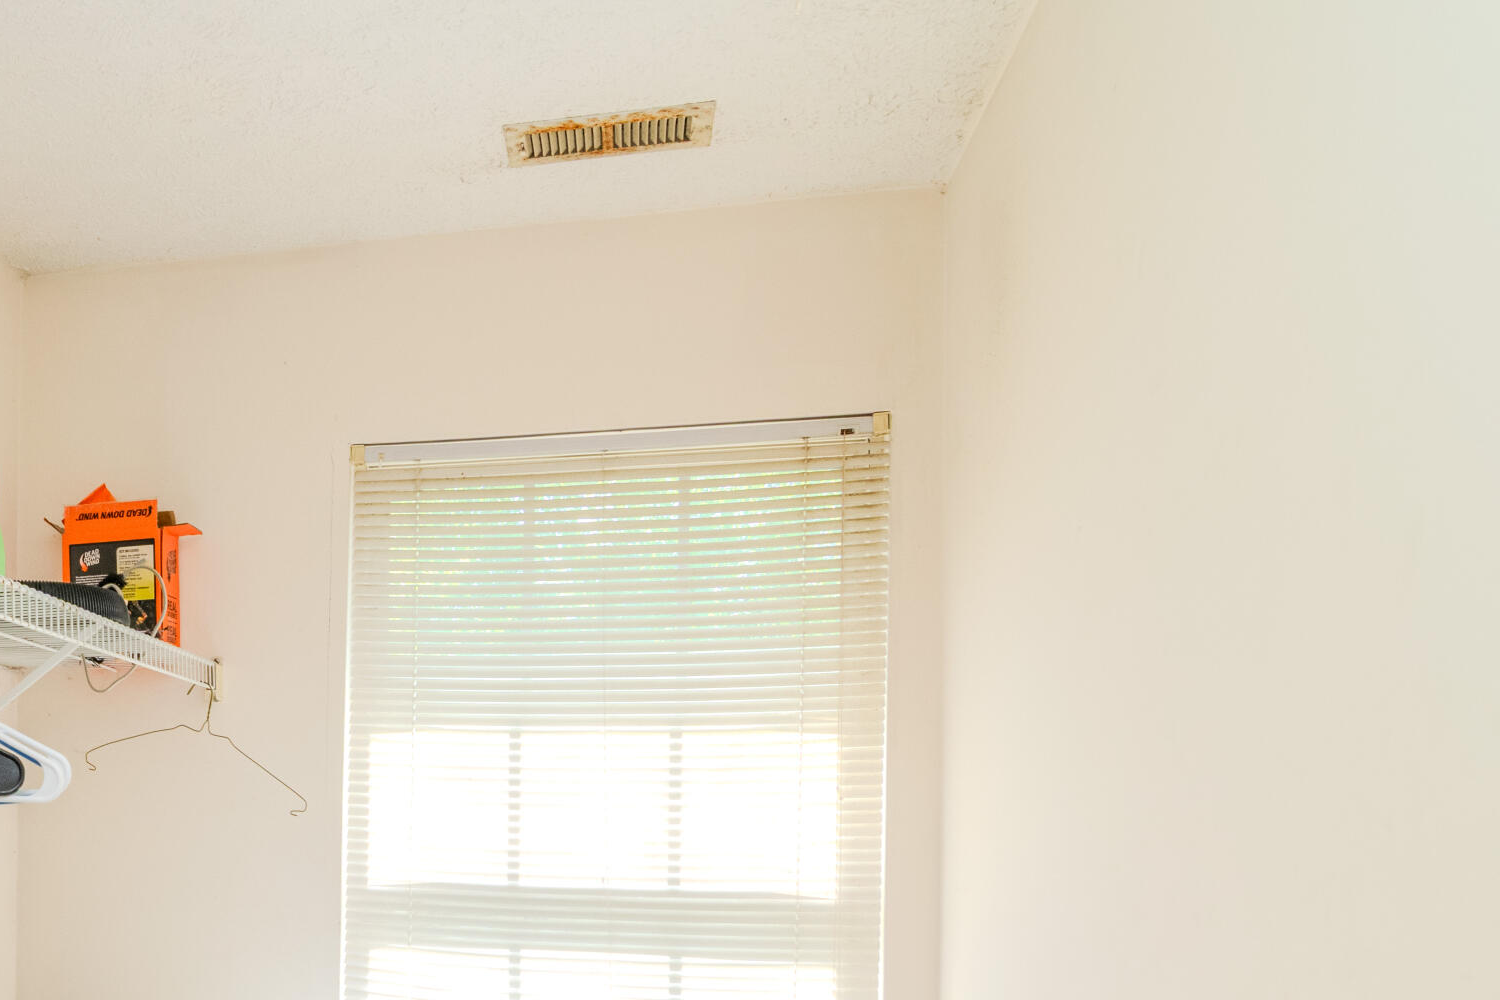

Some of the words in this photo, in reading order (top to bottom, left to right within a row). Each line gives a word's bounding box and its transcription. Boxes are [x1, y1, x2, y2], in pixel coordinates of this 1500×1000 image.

[78, 512, 99, 520] WIND
[100, 510, 125, 519] DOWN
[126, 508, 148, 518] DEAD
[84, 548, 100, 558] DEAD
[83, 554, 100, 563] DOWN
[85, 558, 100, 567] WIND
